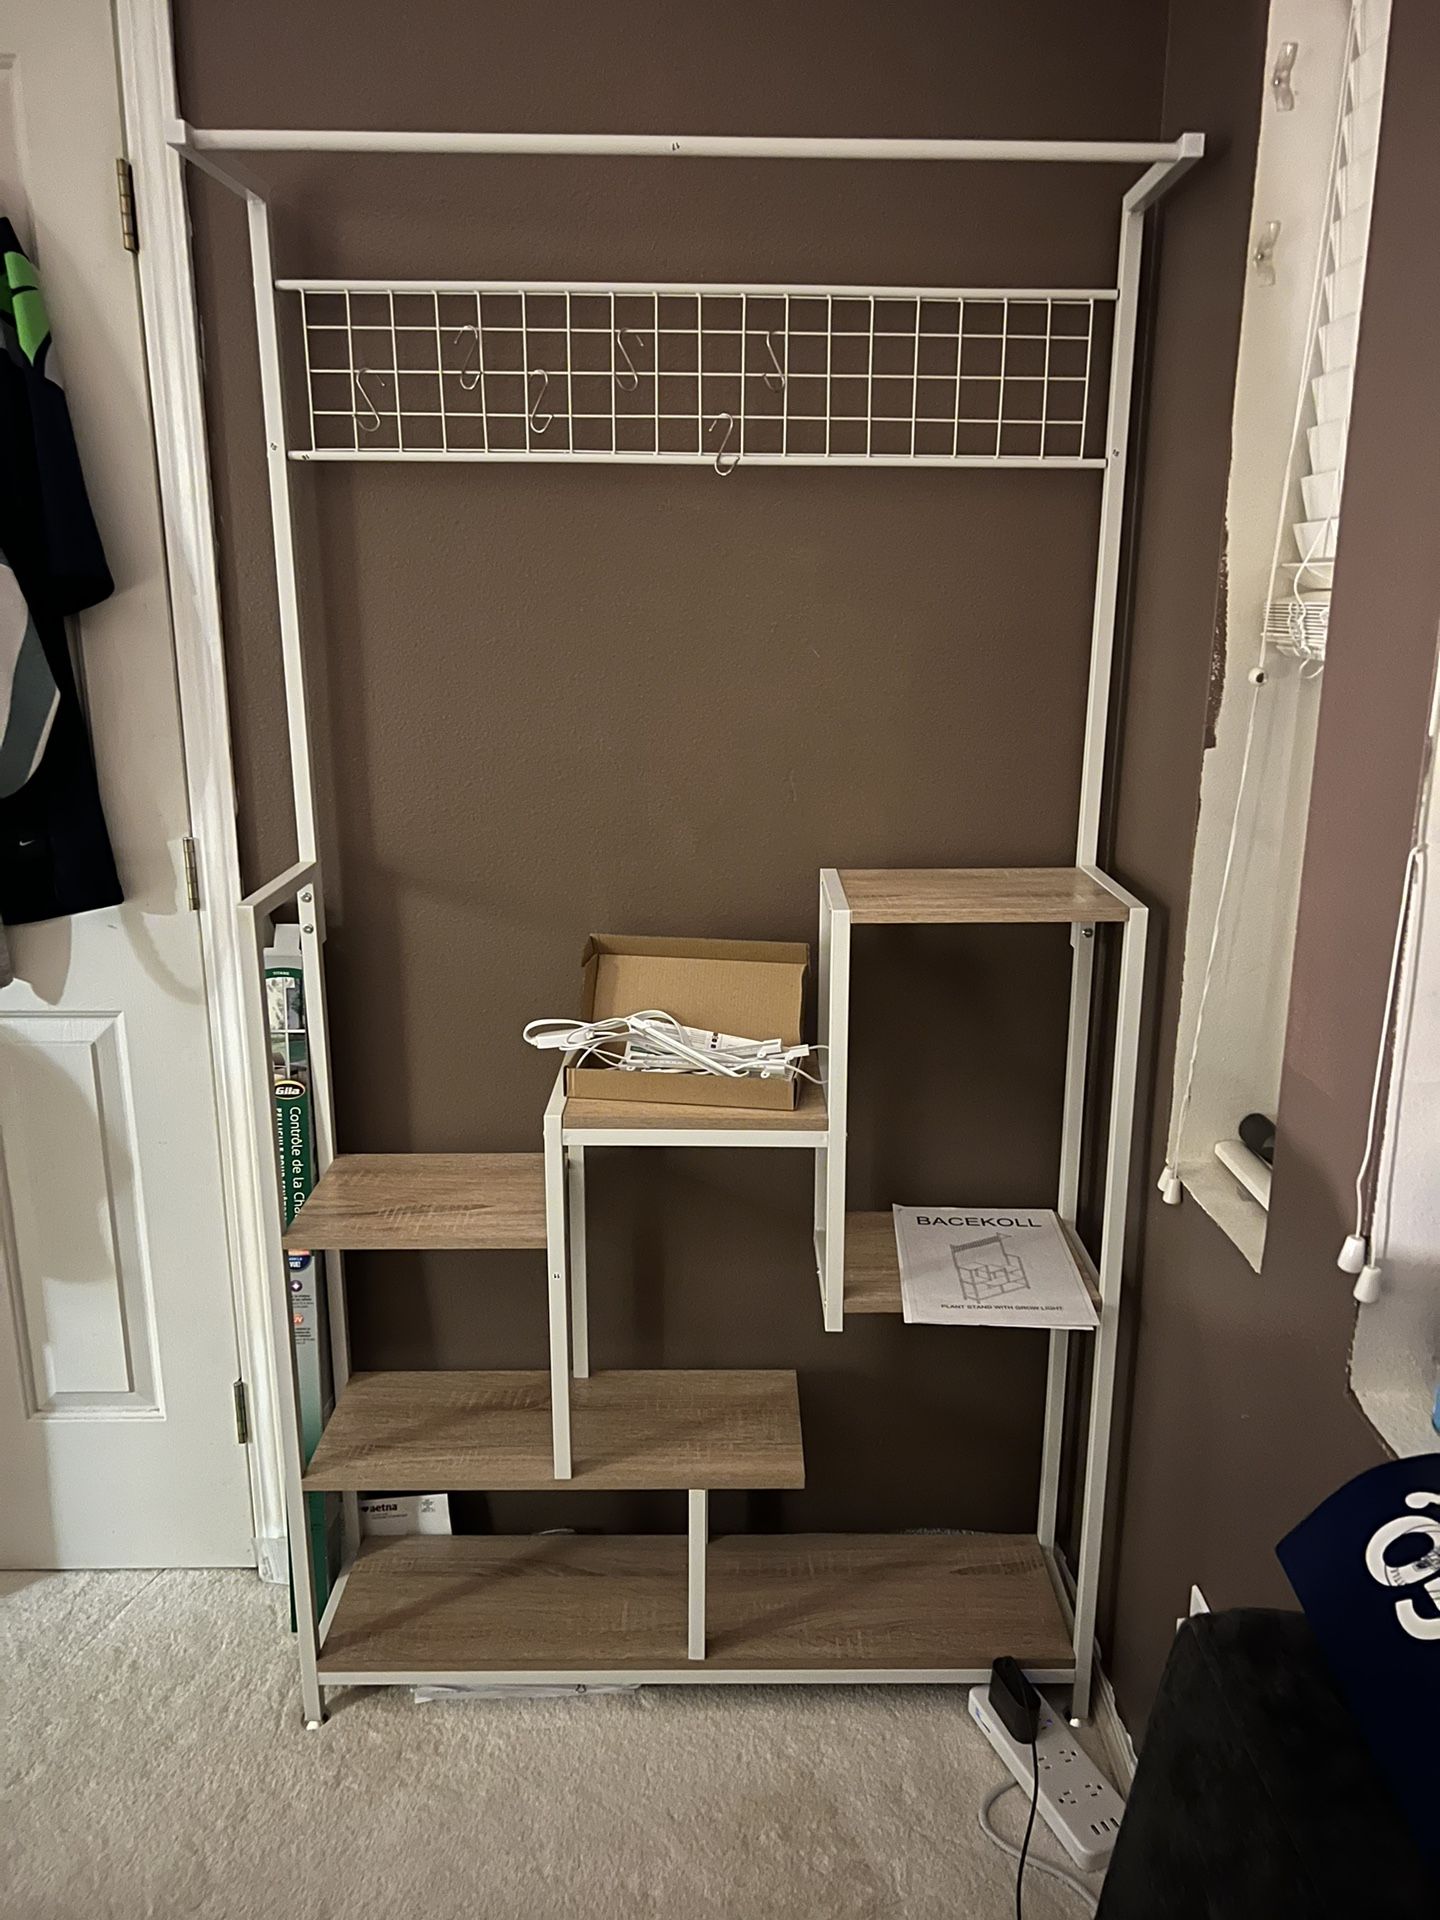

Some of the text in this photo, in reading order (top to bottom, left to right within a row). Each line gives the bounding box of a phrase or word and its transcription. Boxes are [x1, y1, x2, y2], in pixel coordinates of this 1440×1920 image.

[275, 1086, 300, 1095] Gila
[290, 1106, 305, 1218] Contrôle de la Cha
[916, 1216, 1042, 1228] BACEKOLL
[370, 1503, 398, 1513] aetna
